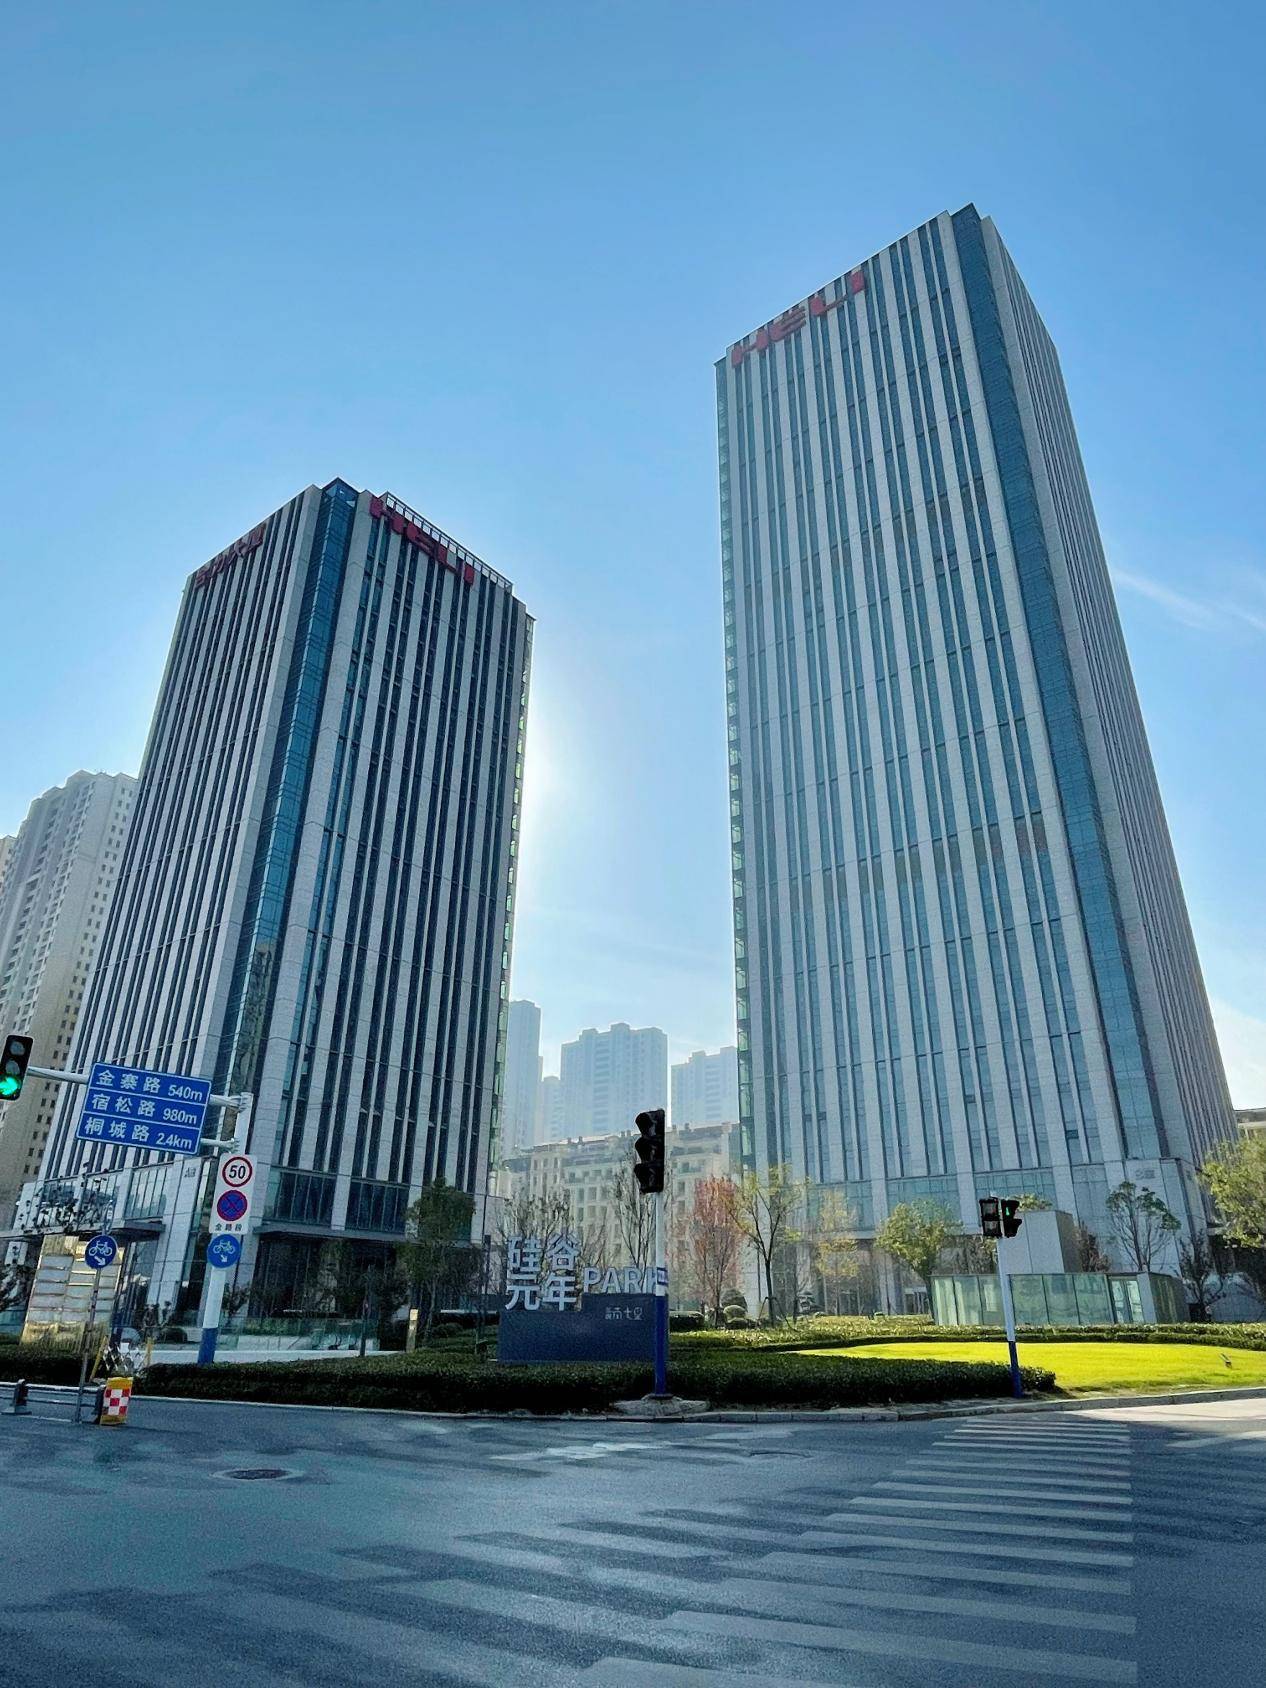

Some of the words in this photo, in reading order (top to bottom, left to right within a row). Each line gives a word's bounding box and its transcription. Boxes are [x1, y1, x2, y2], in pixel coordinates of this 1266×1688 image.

[96, 1069, 161, 1093] 金寨路
[167, 1084, 203, 1101] 540m
[91, 1093, 156, 1118] 宿松路
[162, 1107, 197, 1125] 980m
[84, 1116, 150, 1142] 桐城路
[155, 1131, 193, 1149] 2.4km
[228, 1165, 246, 1180] 50
[507, 1228, 581, 1272] 硅谷
[504, 1272, 578, 1312] 元年
